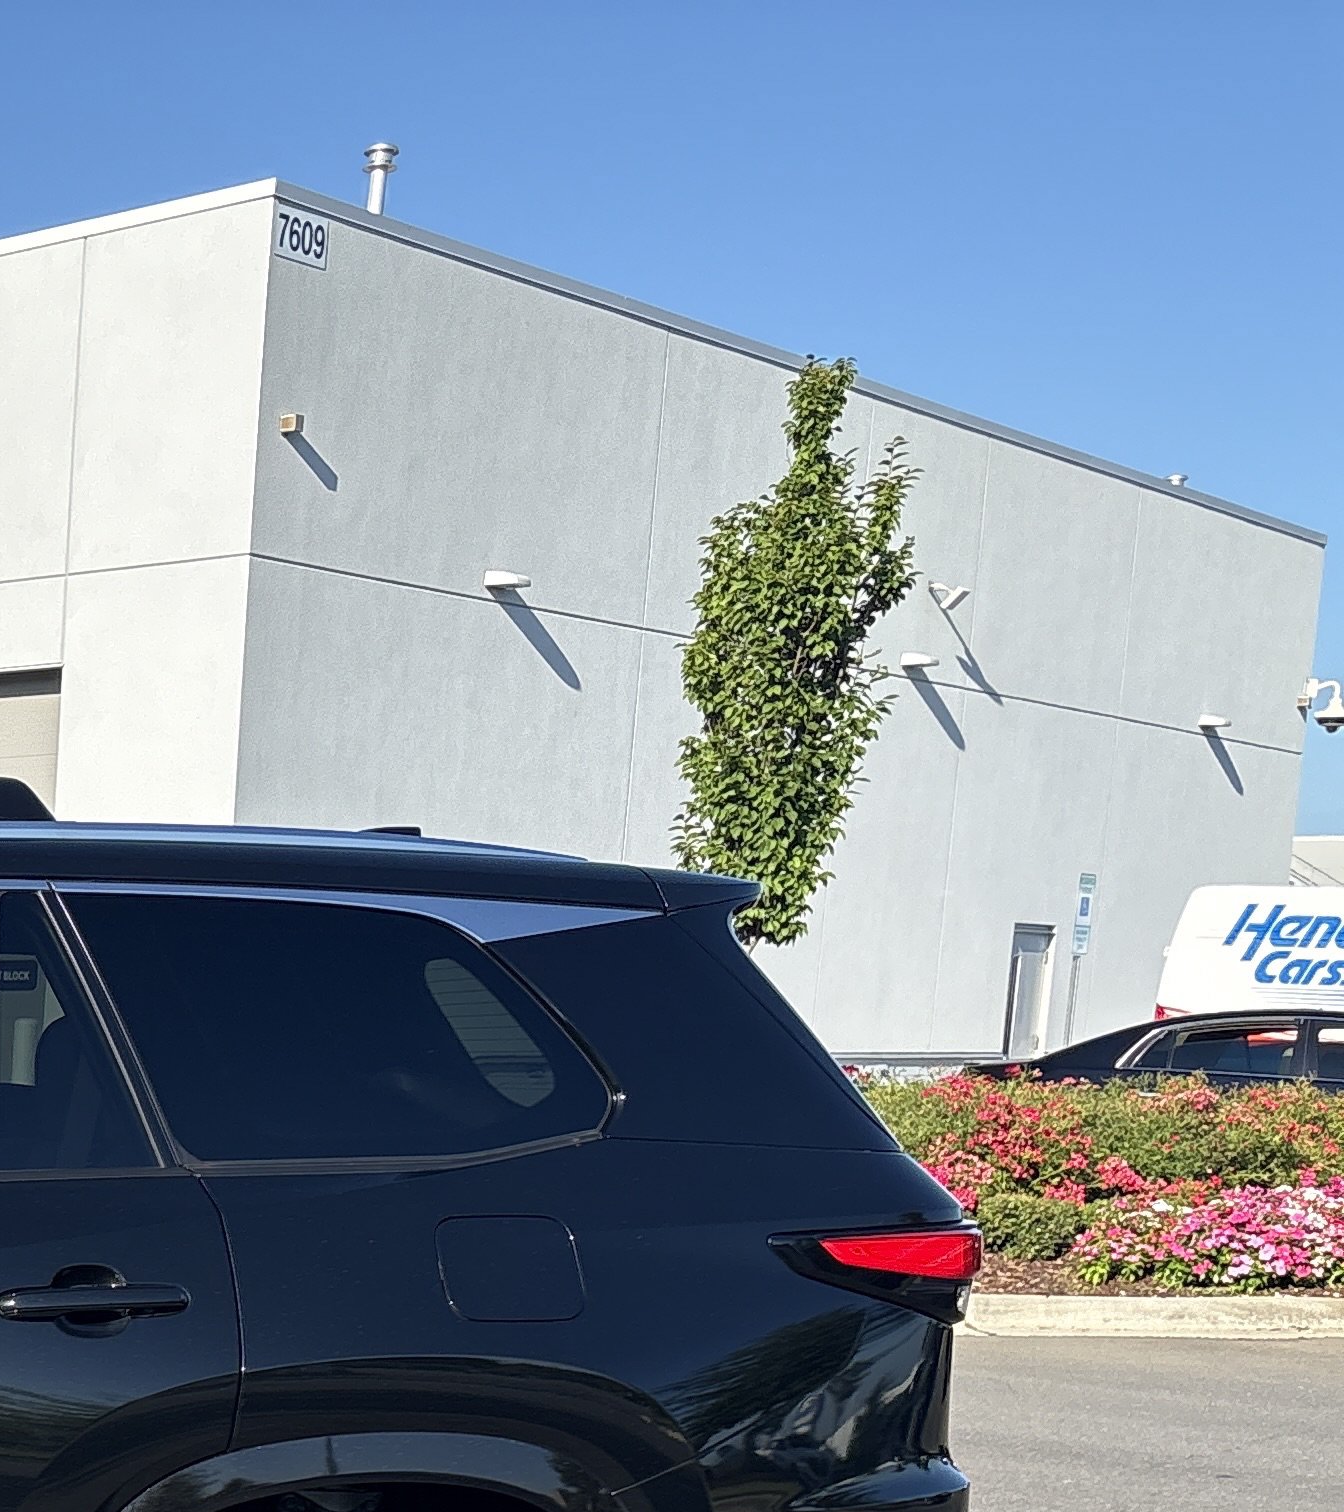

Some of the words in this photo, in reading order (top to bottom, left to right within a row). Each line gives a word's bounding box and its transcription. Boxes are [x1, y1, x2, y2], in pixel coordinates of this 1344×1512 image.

[278, 212, 325, 260] 7609
[1222, 903, 1344, 961] Hen
[3, 970, 30, 981] BLOCK
